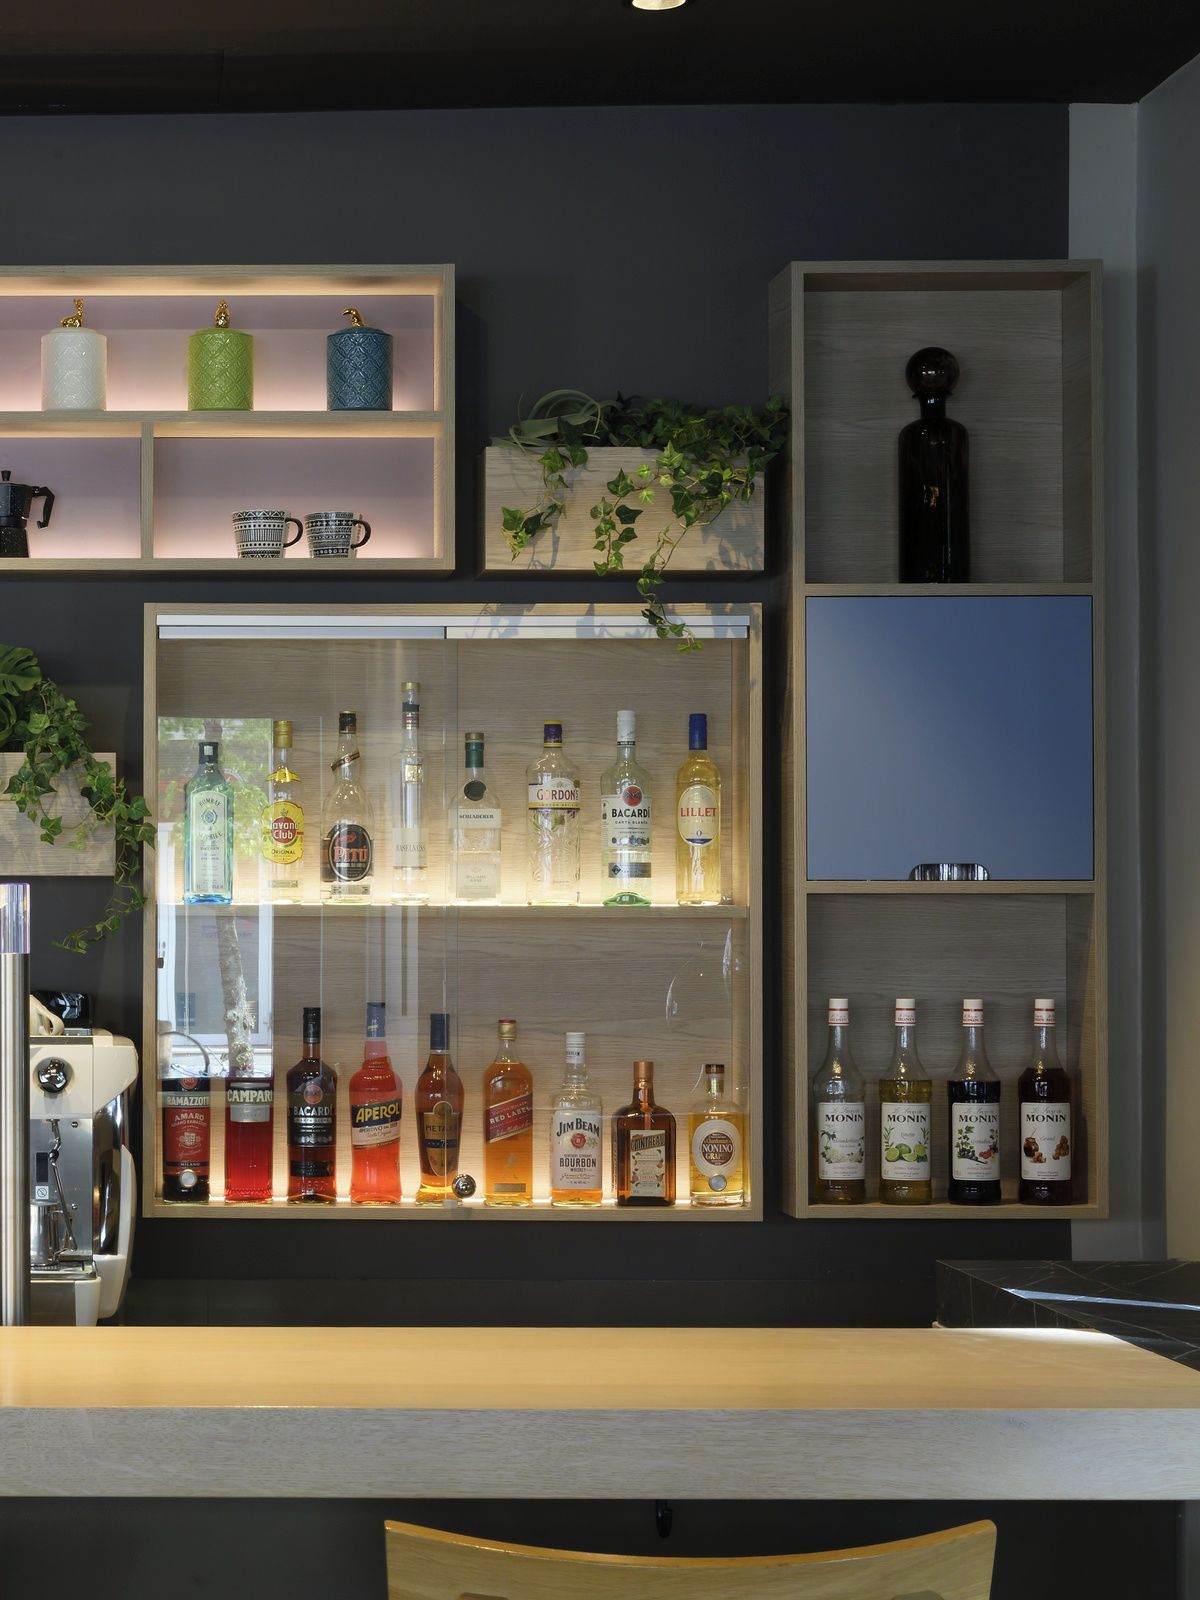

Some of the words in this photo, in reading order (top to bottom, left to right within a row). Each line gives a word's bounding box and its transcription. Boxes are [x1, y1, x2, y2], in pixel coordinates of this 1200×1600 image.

[680, 807, 718, 817] LILLET
[273, 829, 294, 840] Club
[333, 845, 368, 863] PITÚ
[174, 1112, 205, 1122] AMARO
[355, 1101, 400, 1124] APEROL
[489, 1114, 506, 1125] RED
[507, 1106, 531, 1119] LABEL
[825, 1114, 865, 1122] MONIN
[887, 1114, 927, 1123] MONIN
[958, 1114, 999, 1123] MONIN
[1026, 1114, 1067, 1122] MONIN
[556, 1120, 575, 1138] JIM
[575, 1117, 600, 1138] BEAM
[702, 1143, 733, 1153] NONINO
[559, 1157, 597, 1168] BOURBON
